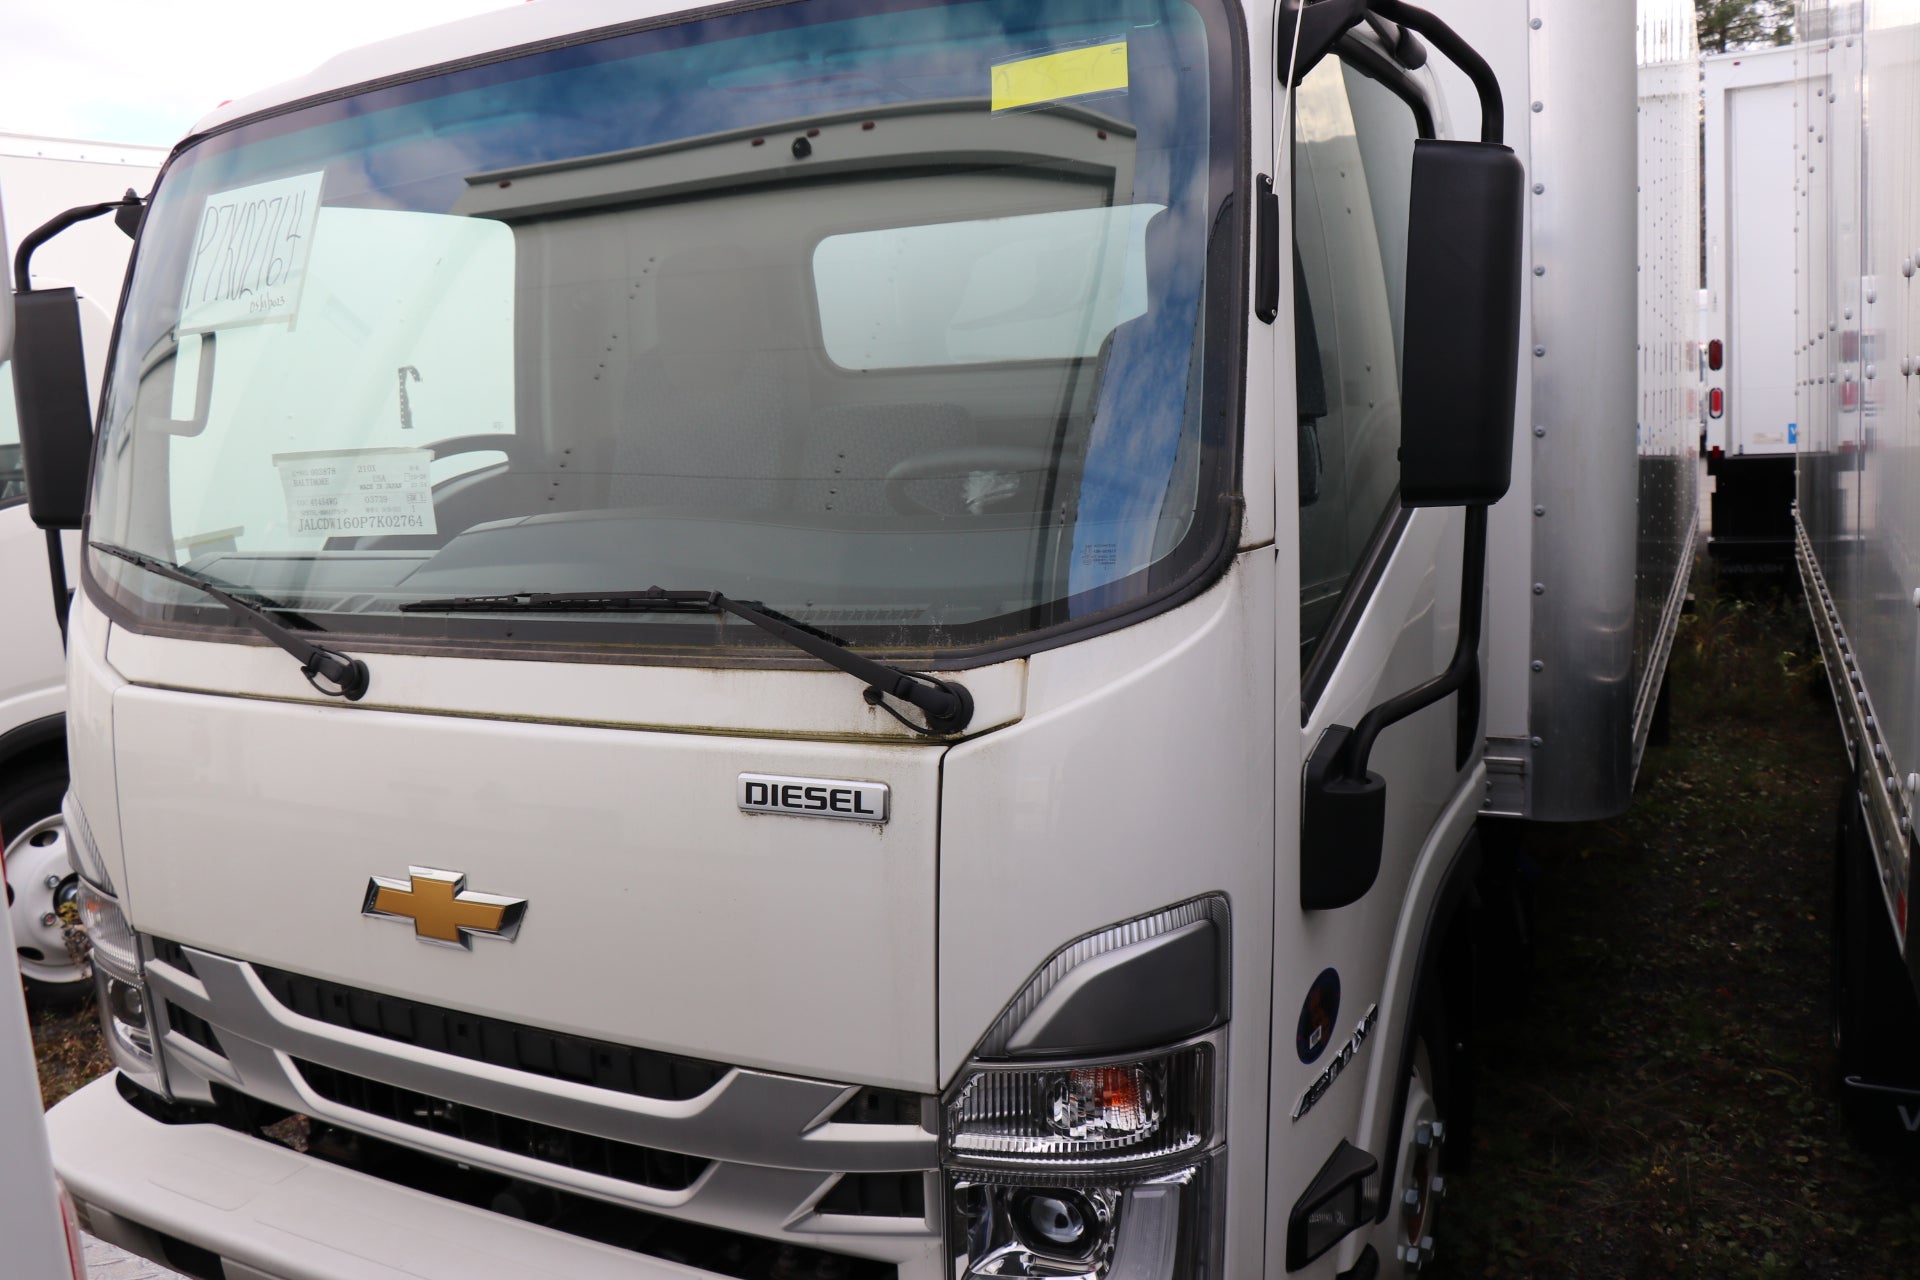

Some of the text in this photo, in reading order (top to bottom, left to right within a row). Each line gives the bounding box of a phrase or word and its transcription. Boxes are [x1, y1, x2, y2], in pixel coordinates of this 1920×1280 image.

[185, 189, 306, 310] P7K02764
[297, 515, 423, 532] JALCDW160P7K02764
[745, 781, 874, 814] DIESEL
